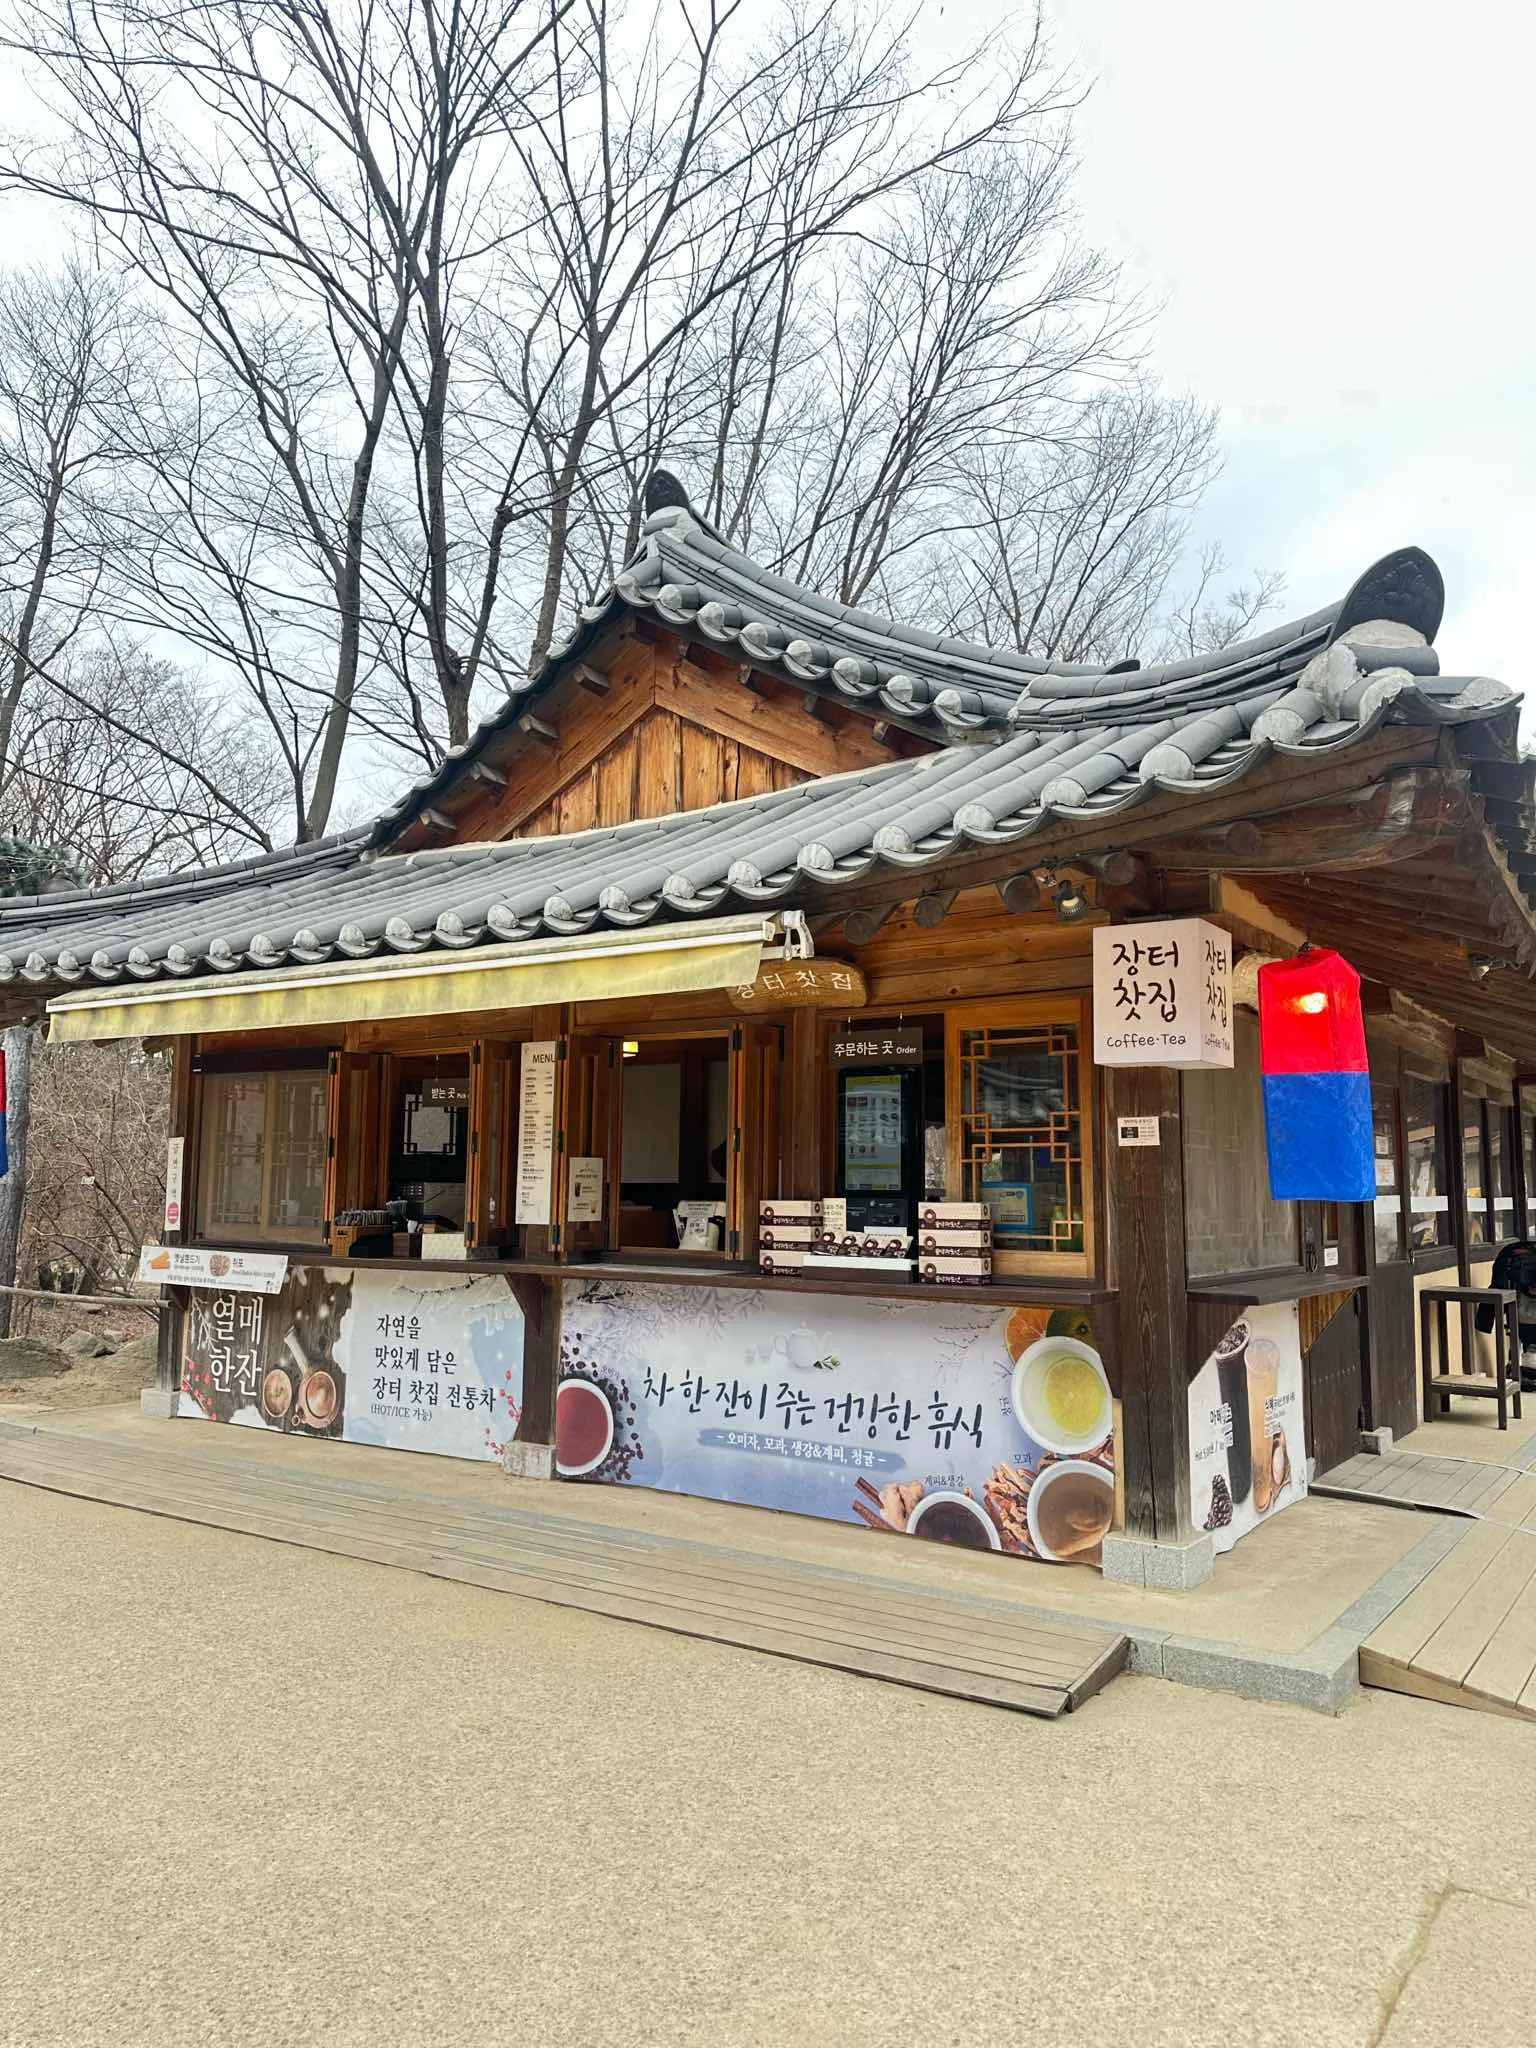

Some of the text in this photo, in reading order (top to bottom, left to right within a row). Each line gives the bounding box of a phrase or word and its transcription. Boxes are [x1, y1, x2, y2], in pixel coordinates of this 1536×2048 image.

[1112, 939, 1179, 976] 장터
[1205, 939, 1227, 976] 장터
[1113, 978, 1177, 1023] 찻집
[1206, 975, 1227, 1028] 찻집
[834, 1040, 917, 1057] 주문하는 곳 Order
[431, 1087, 446, 1099] 받는
[447, 1087, 456, 1099] 곳
[213, 1294, 264, 1345] 열매
[376, 1314, 422, 1340] 자연을
[209, 1346, 262, 1396] 한잔
[375, 1345, 457, 1375] 맛있게 담은
[372, 1376, 496, 1413] 장터 찻집 전통차
[643, 1366, 983, 1450] 차 한 잔이 주는 건강한 휴식
[1013, 1452, 1032, 1464] 모과
